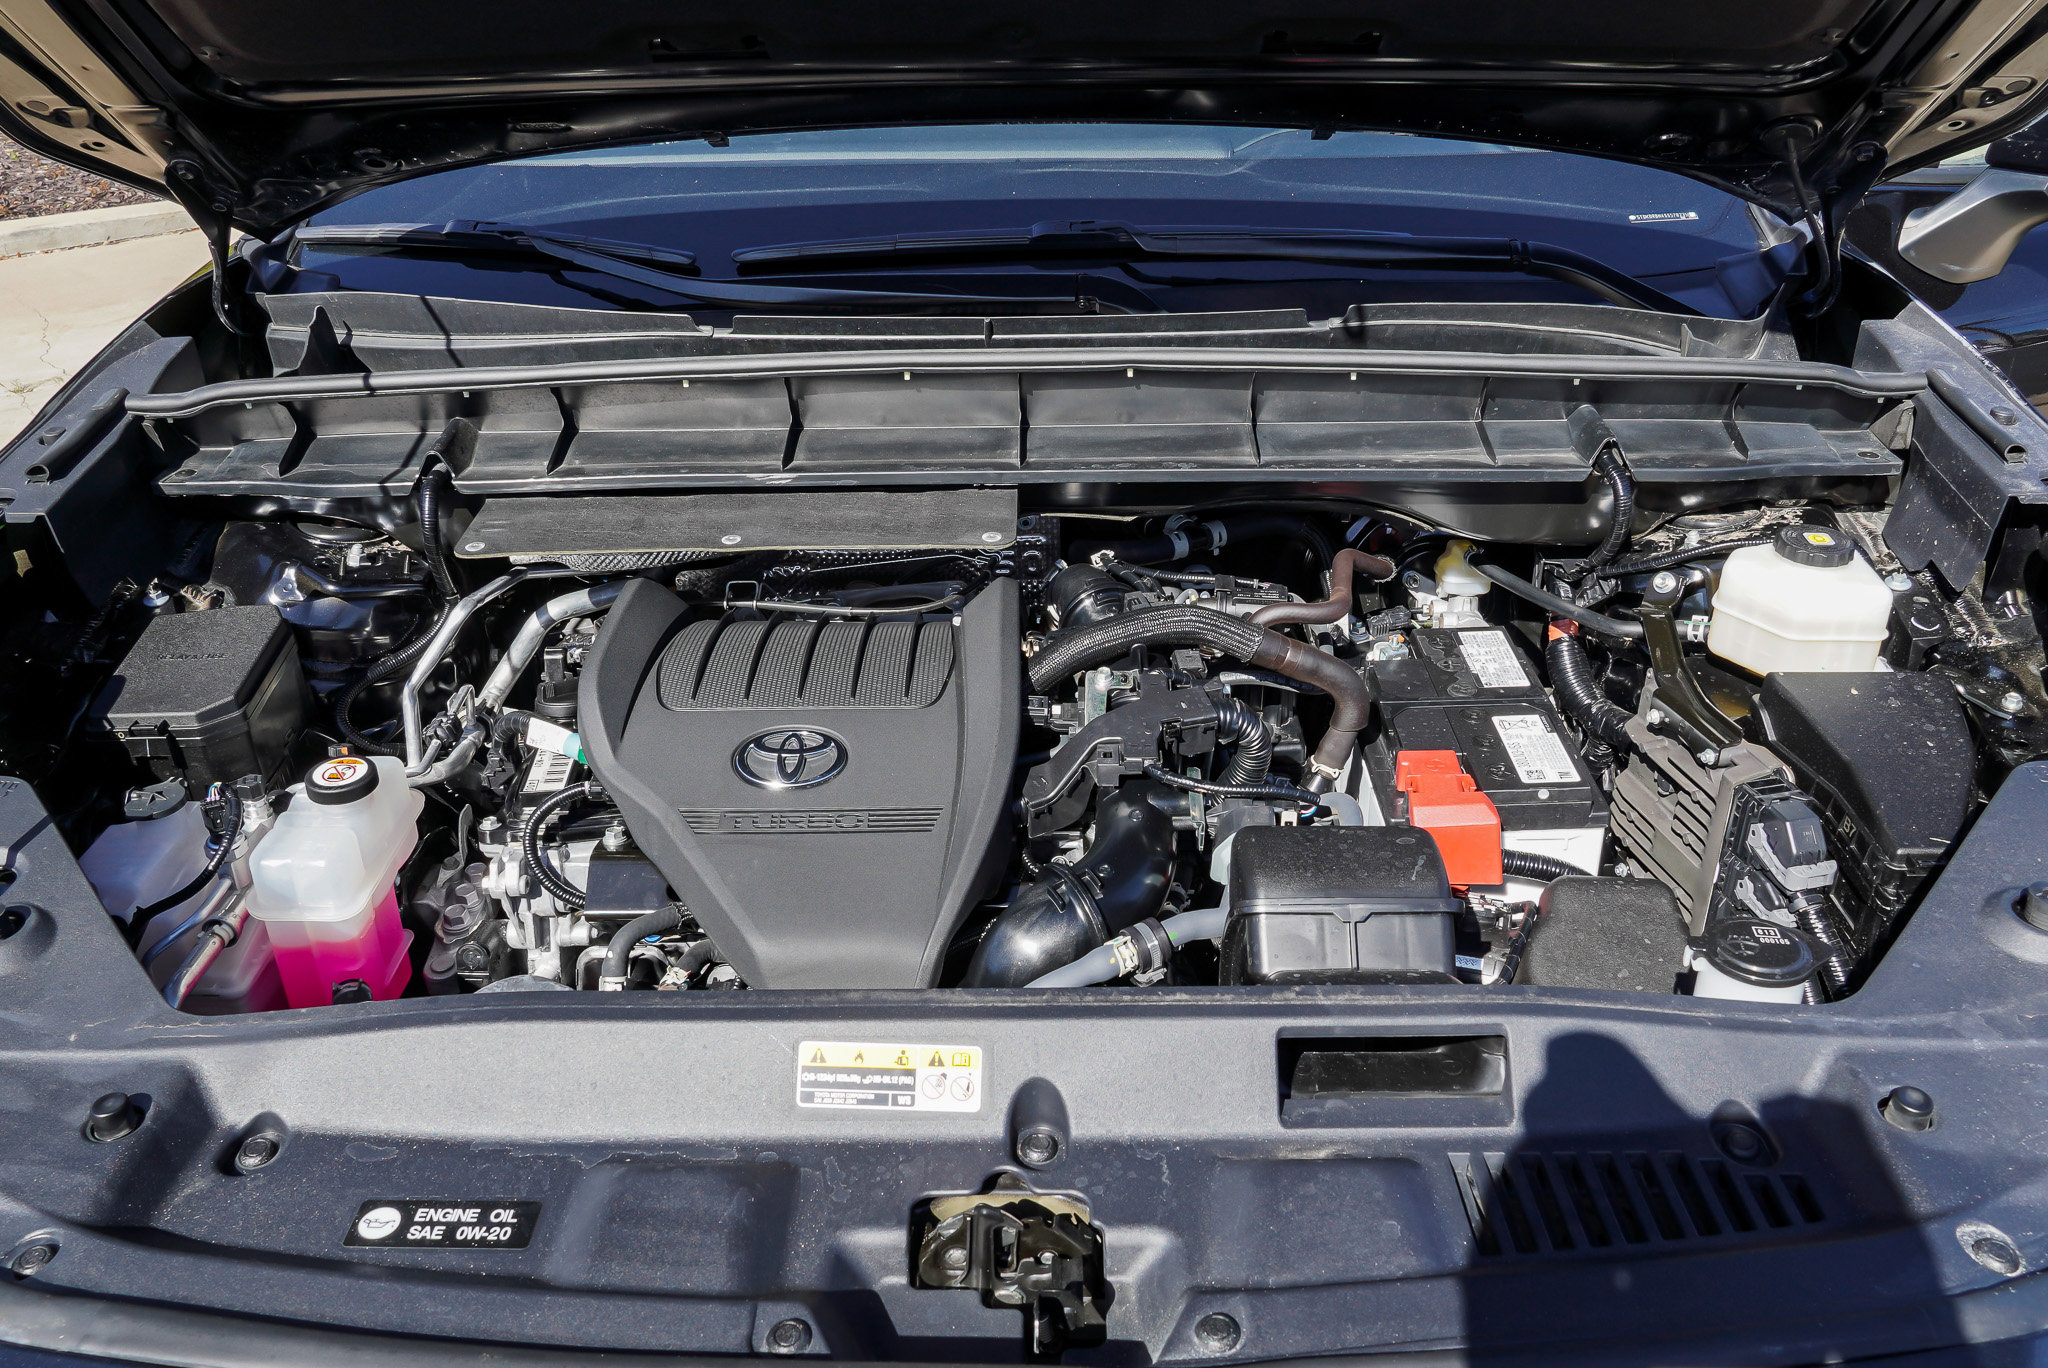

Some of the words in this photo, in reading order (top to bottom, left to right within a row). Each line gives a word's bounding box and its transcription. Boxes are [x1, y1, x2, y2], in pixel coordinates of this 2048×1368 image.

[724, 812, 866, 829] TURBO
[1843, 816, 1857, 837] B7
[413, 1208, 482, 1223] ENGINE
[489, 1208, 519, 1224] OIL
[406, 1225, 447, 1241] SAE
[455, 1226, 513, 1242] 0W-20
